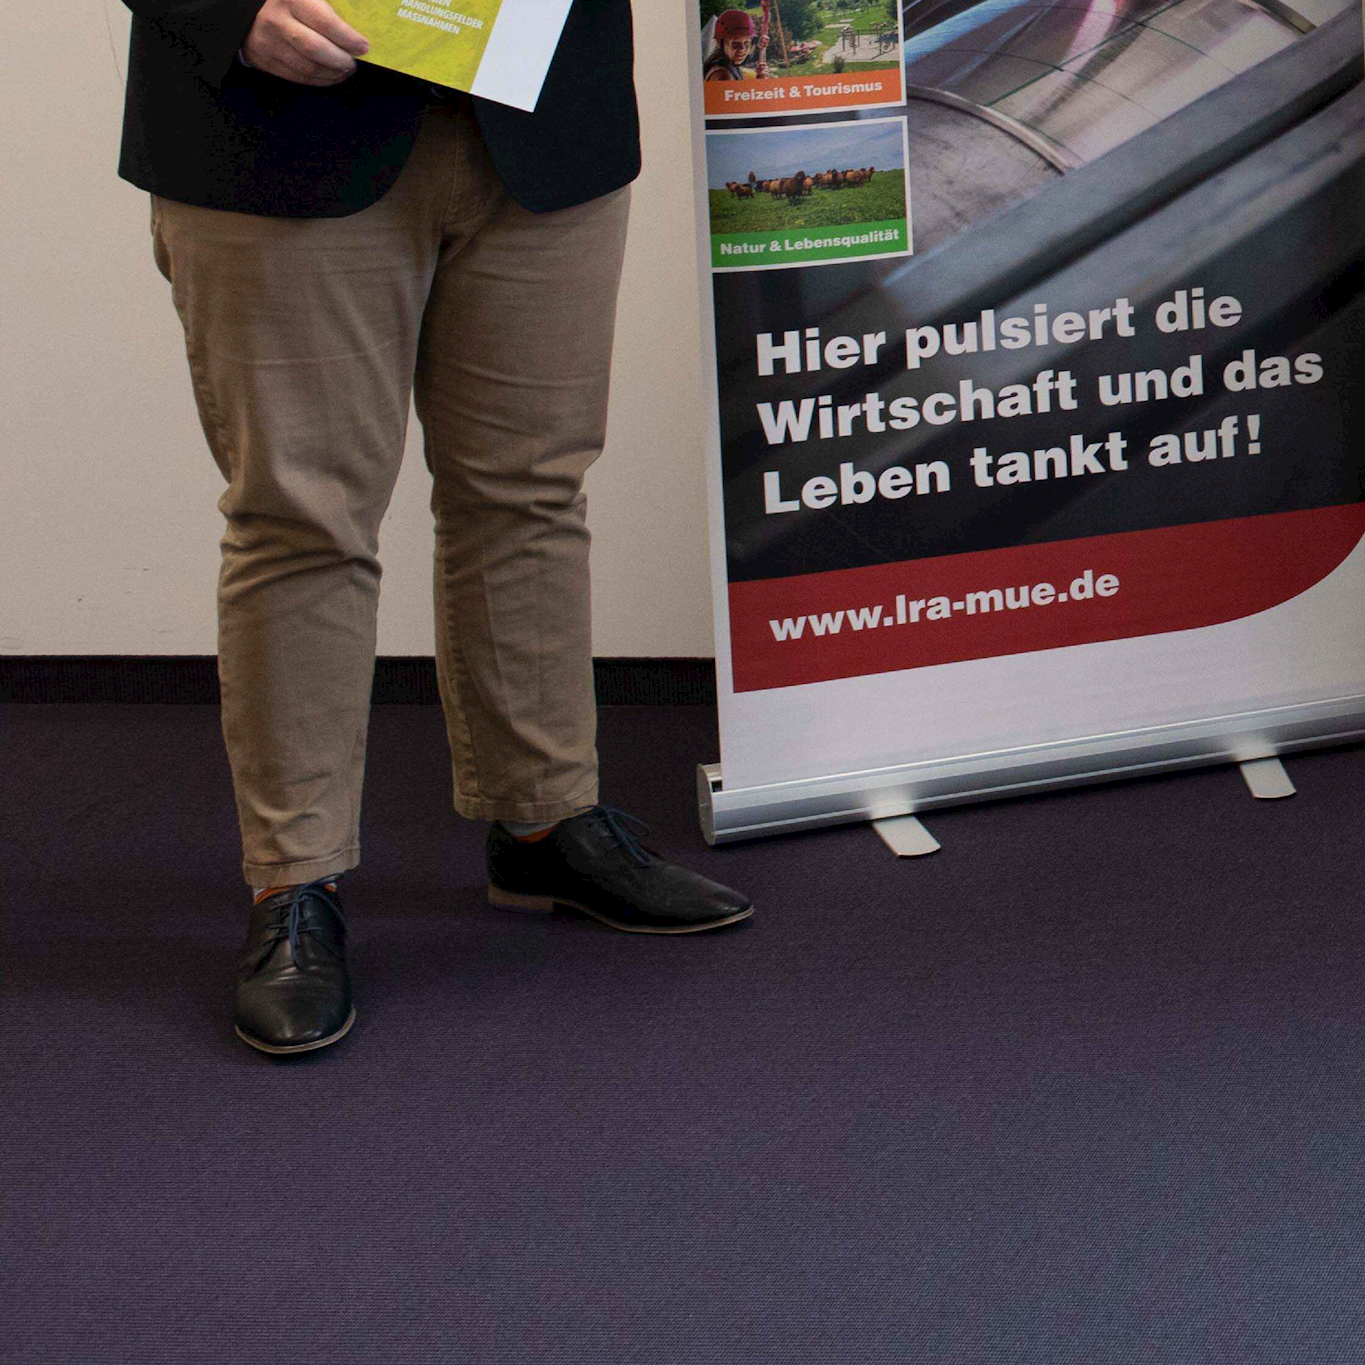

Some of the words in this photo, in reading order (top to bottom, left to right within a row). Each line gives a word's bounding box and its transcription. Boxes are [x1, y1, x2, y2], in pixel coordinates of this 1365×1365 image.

[397, 7, 460, 34] MASSNAHMEN
[724, 86, 785, 102] Freizeit
[788, 86, 802, 98] &
[803, 80, 883, 97] Tourismus
[719, 241, 766, 256] Natur
[769, 240, 782, 252] &
[784, 228, 900, 251] Lebensqualität
[755, 327, 886, 377] Hier
[904, 297, 1135, 371] pulsiert
[1154, 287, 1244, 333] die
[757, 370, 1078, 446] Wirtschaft
[1097, 356, 1203, 408] und
[1223, 350, 1325, 393] das
[762, 452, 951, 515] Leben
[970, 431, 1129, 488] tankt
[1147, 414, 1263, 468] auf!
[768, 570, 1121, 643] www.lra-mue.de
